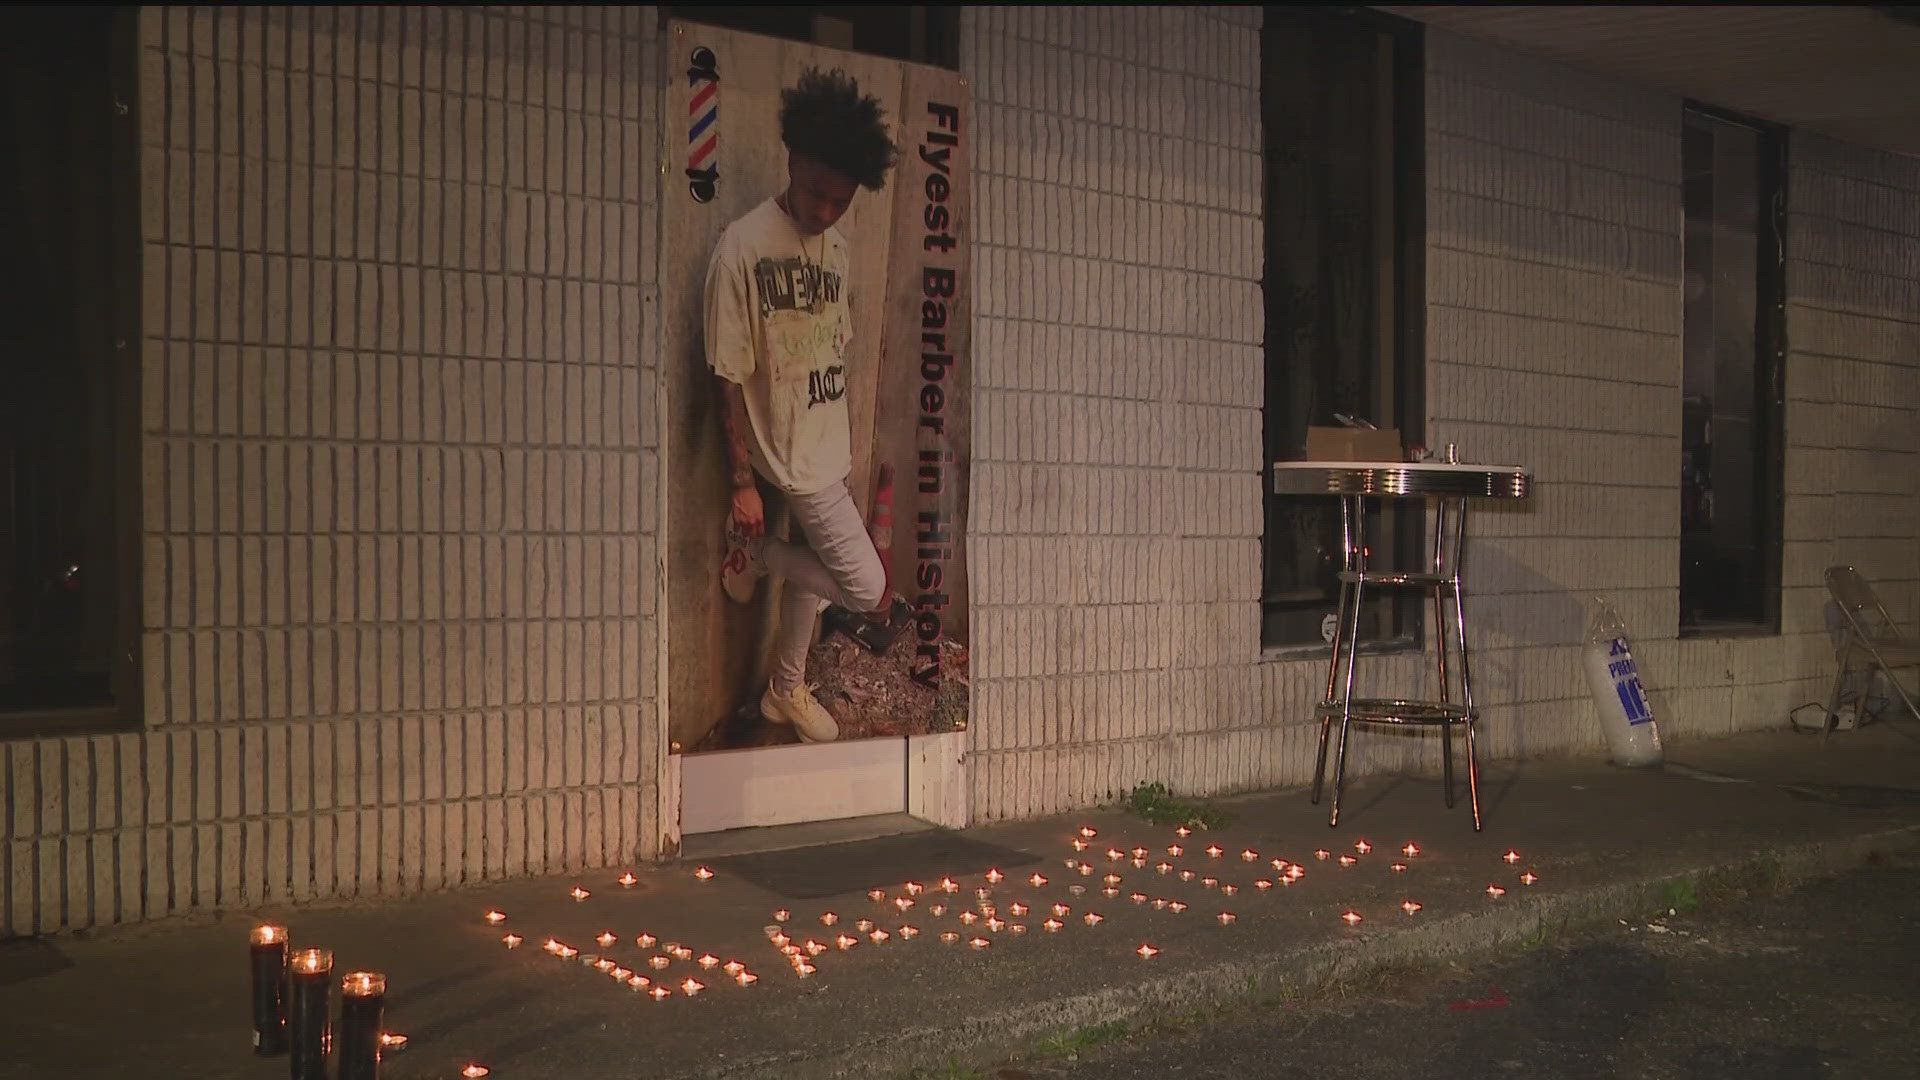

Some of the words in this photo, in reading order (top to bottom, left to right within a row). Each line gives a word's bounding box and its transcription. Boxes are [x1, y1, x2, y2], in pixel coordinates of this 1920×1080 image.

[919, 102, 959, 253] Flyest
[920, 266, 955, 435] Barber
[918, 450, 954, 494] in
[910, 511, 953, 691] History
